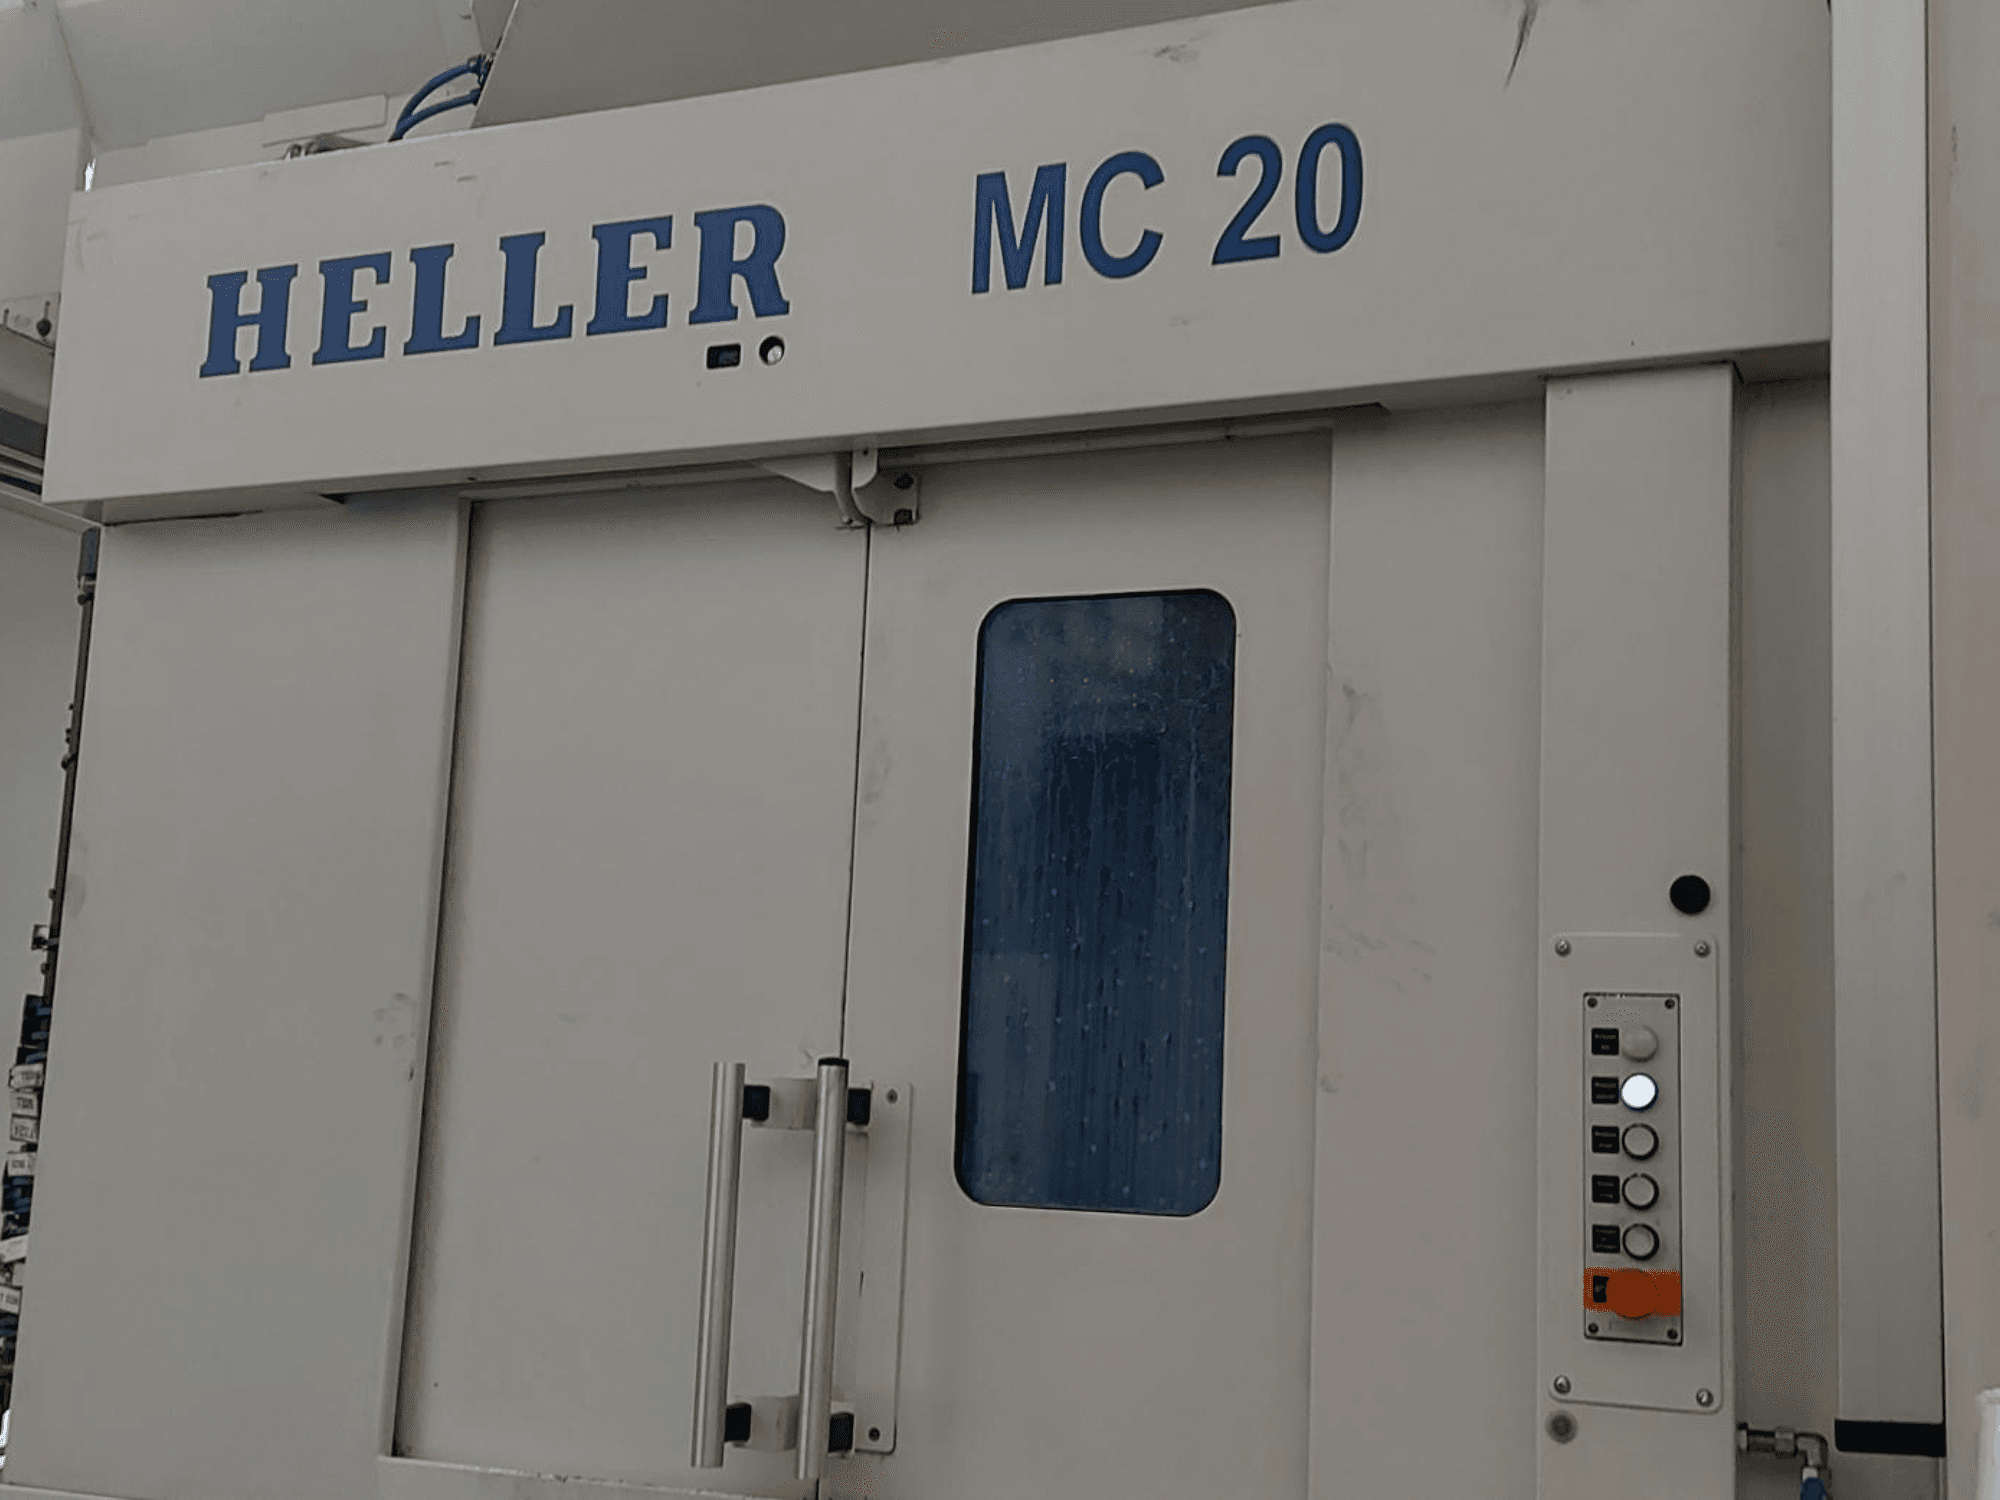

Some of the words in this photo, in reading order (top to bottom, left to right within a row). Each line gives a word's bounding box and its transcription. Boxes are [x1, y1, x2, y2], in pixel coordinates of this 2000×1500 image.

[199, 203, 790, 379] HELLER
[971, 151, 1165, 295] MC
[1212, 122, 1364, 266] 20
